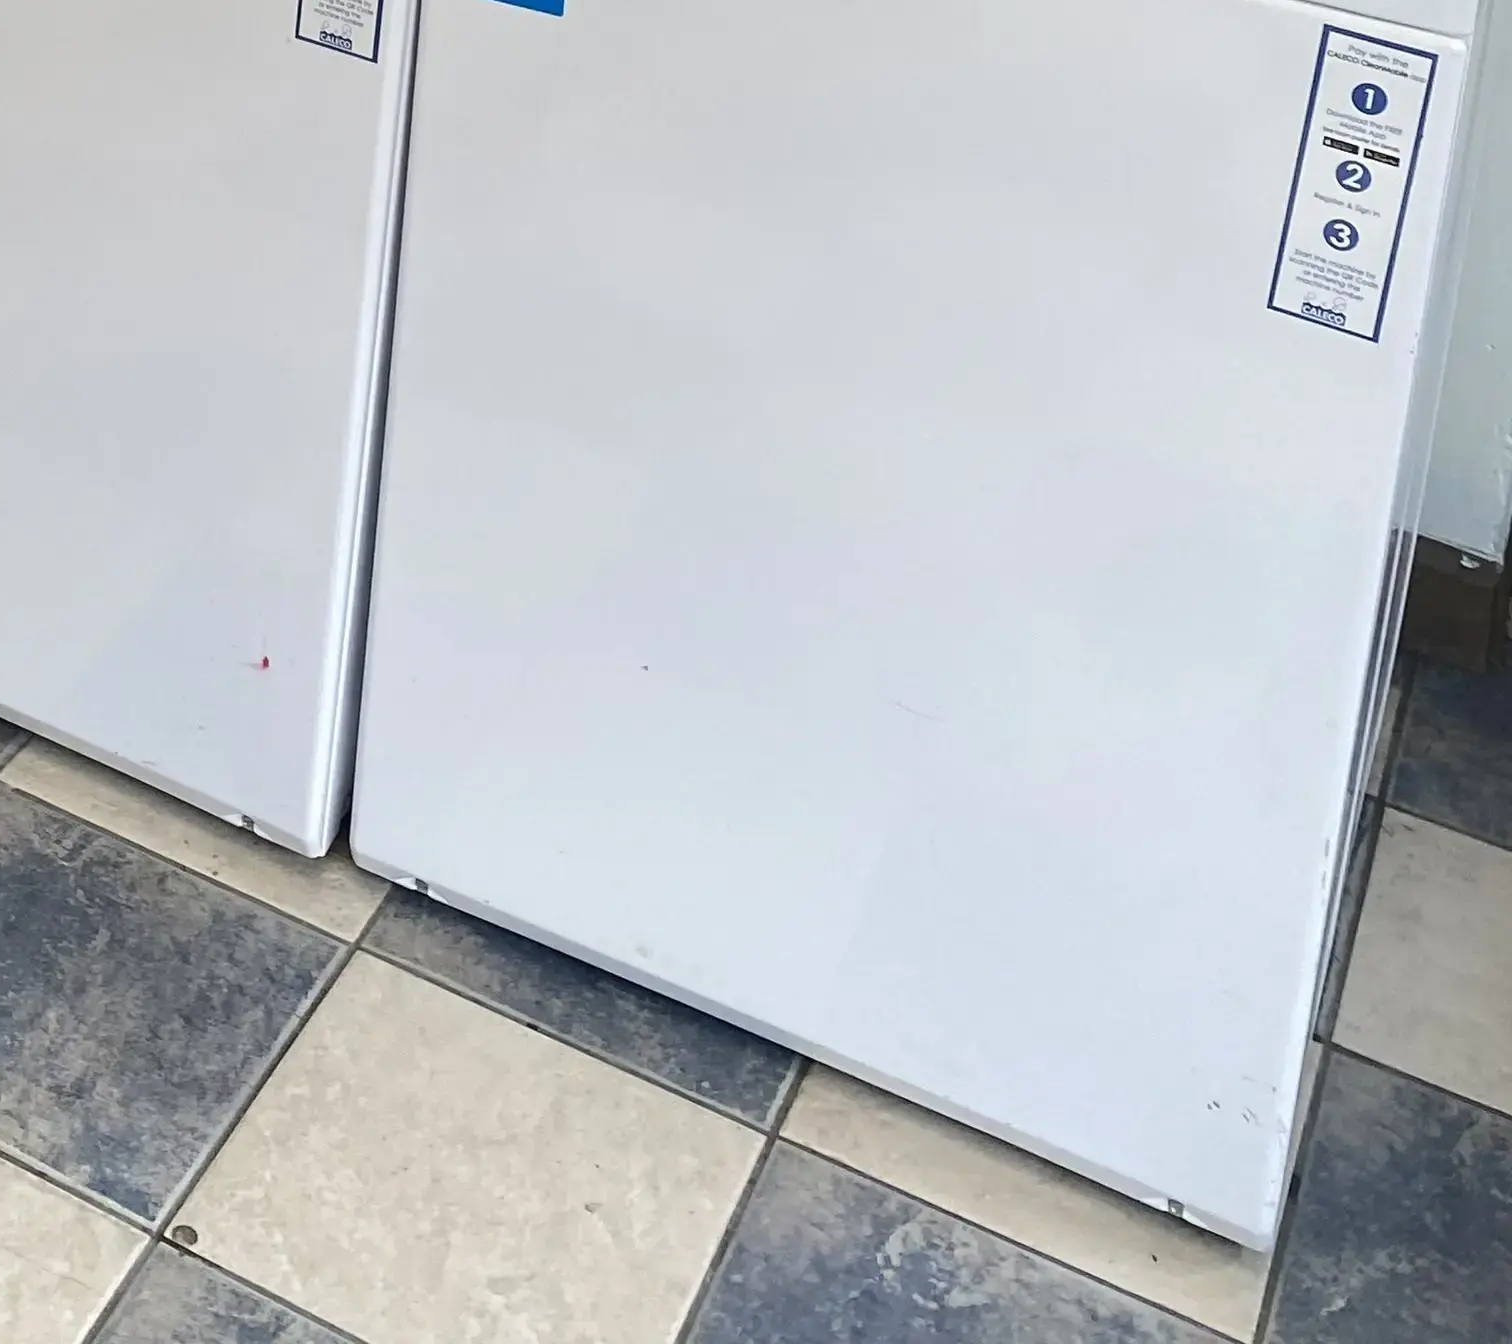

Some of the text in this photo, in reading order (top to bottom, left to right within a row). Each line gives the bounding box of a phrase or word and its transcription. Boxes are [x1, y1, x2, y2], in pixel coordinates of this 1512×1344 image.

[320, 33, 351, 48] CALECO
[1328, 50, 1359, 64] CALECO
[1361, 59, 1408, 77] CleanMobile
[1348, 44, 1408, 68] Pay with the
[1364, 88, 1375, 110] 1
[1342, 163, 1364, 189] 2
[1329, 222, 1351, 248] 3
[1302, 304, 1344, 324] CALECO
